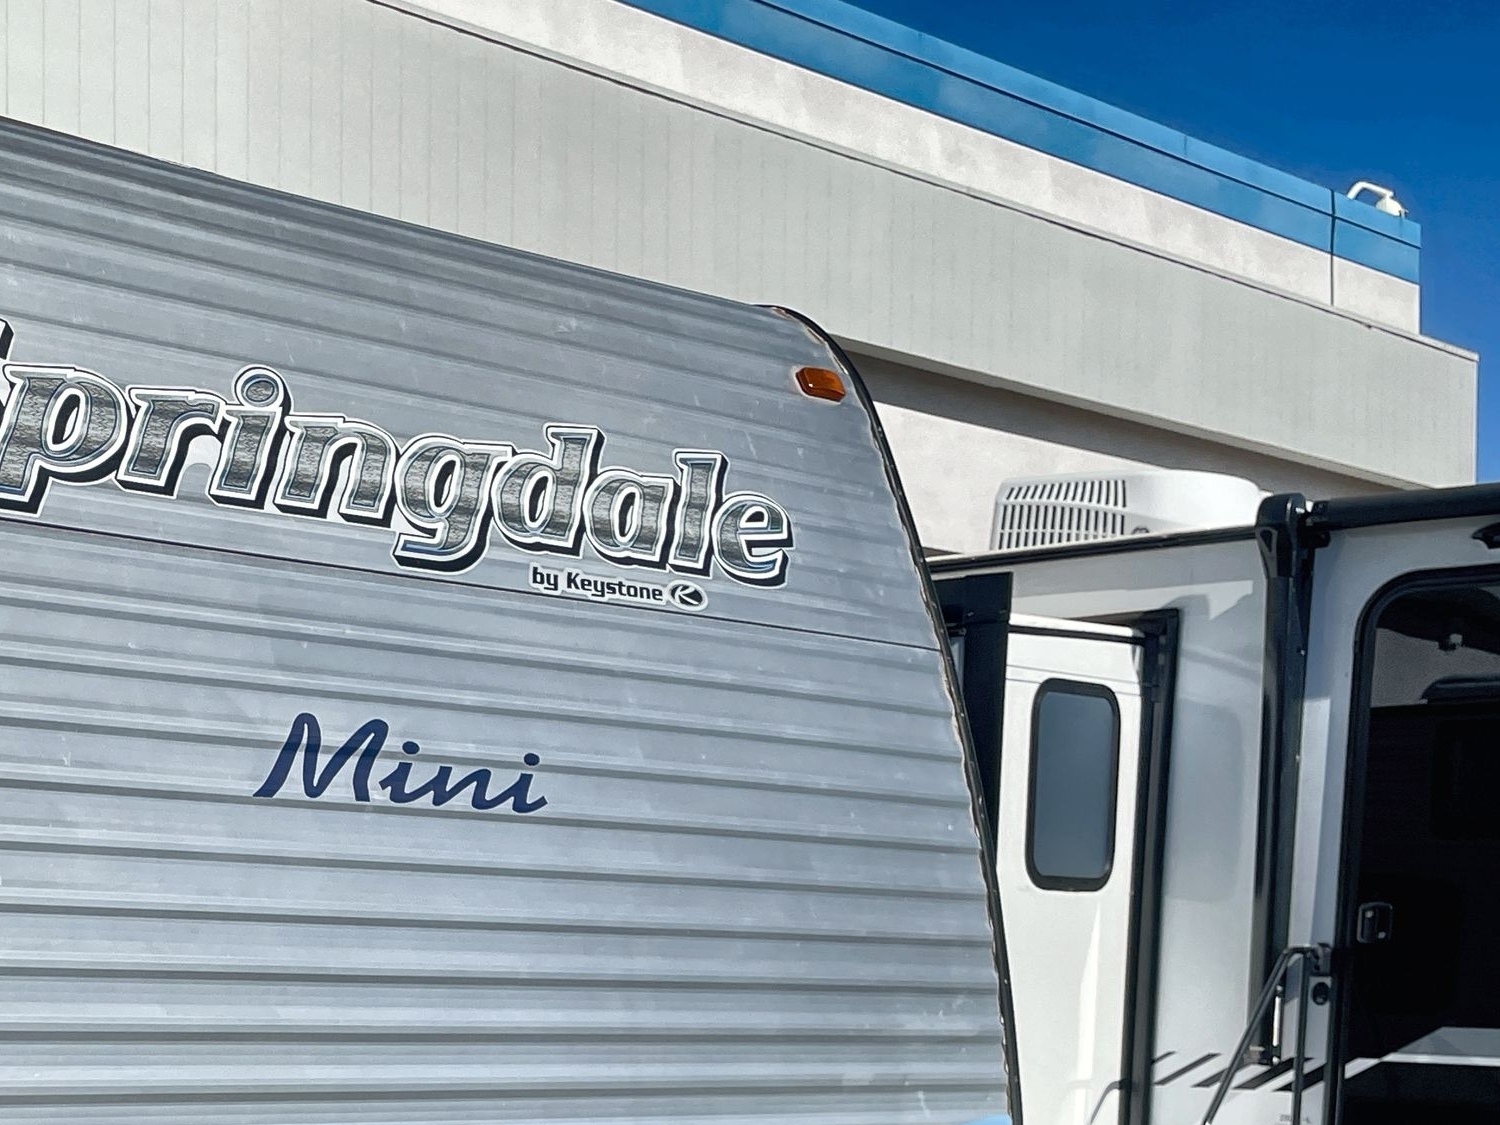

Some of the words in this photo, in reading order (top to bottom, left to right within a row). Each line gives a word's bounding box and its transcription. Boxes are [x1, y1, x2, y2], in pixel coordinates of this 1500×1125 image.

[532, 566, 559, 591] by
[566, 571, 663, 602] Keystone
[252, 710, 547, 815] Mini
